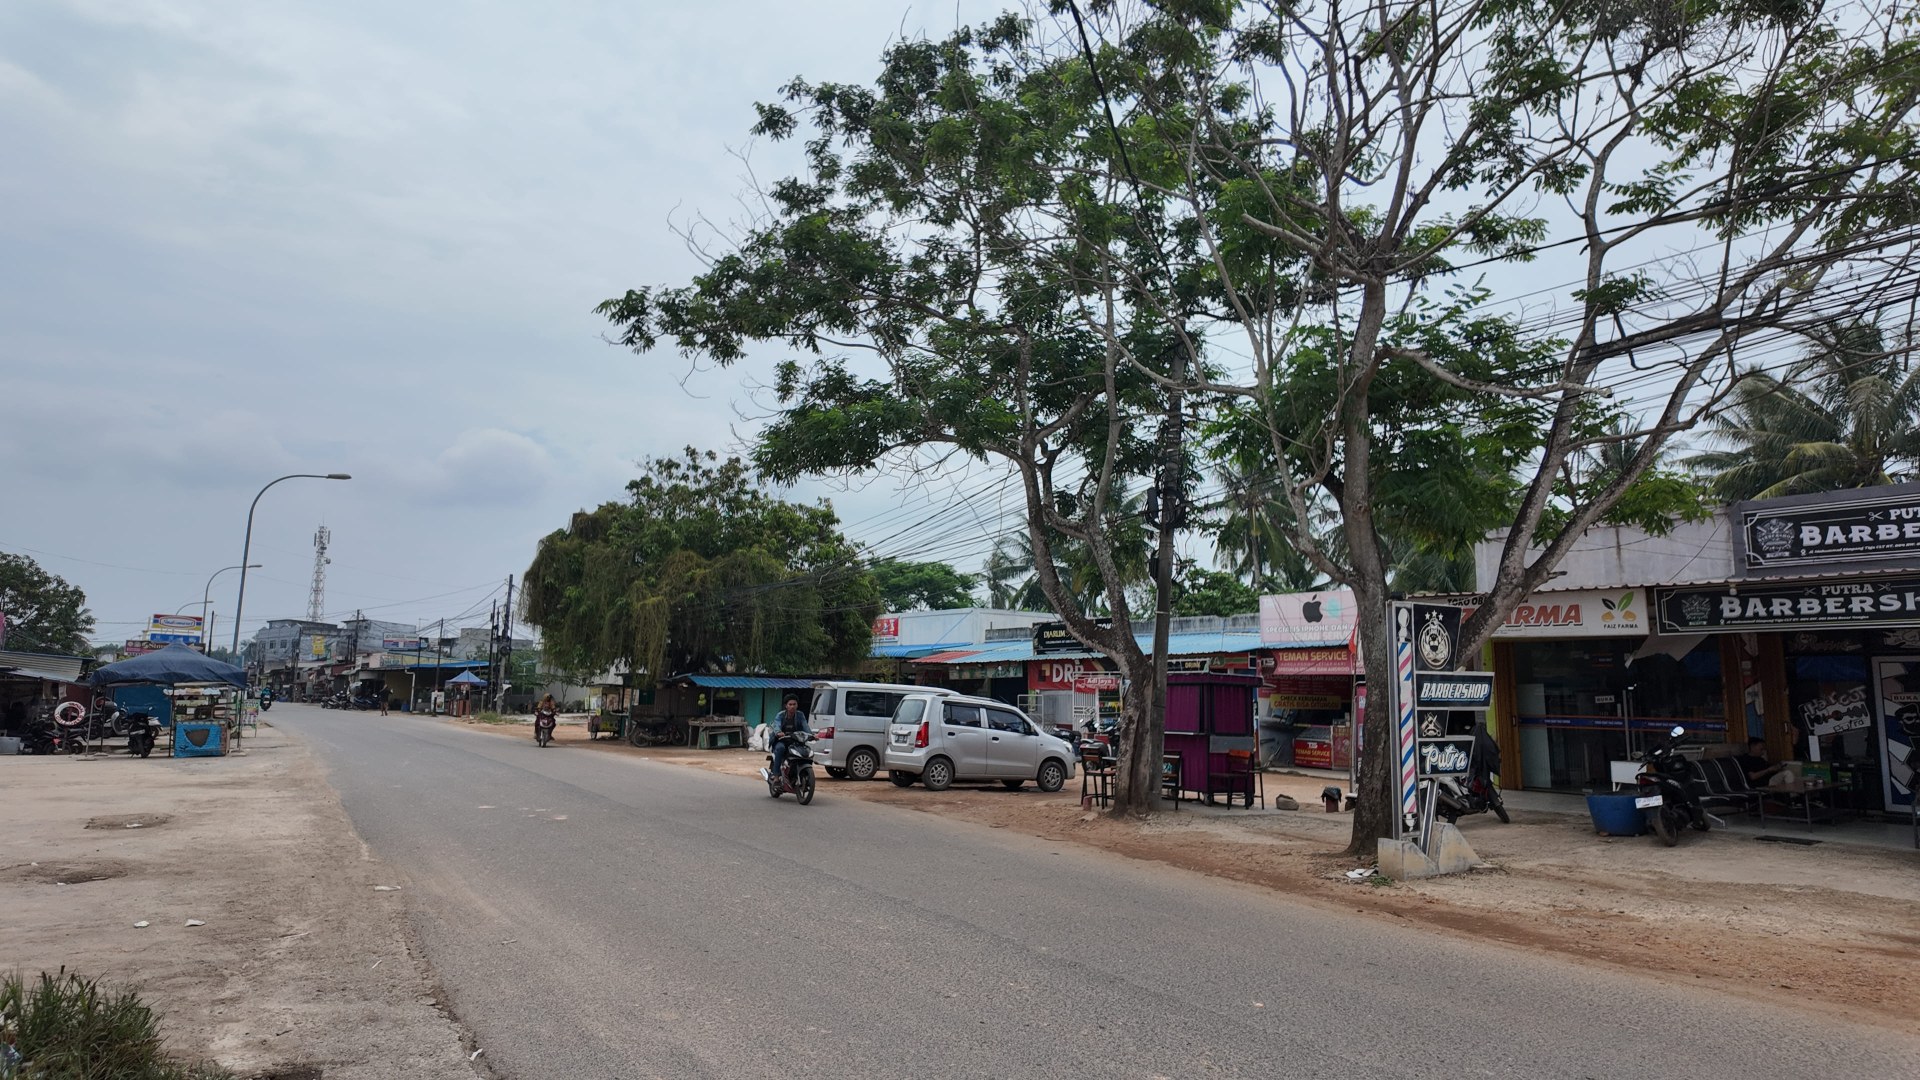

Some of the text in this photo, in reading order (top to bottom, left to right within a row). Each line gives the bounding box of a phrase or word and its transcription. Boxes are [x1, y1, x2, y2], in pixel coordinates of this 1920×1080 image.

[1800, 523, 1920, 547] BARBE
[1821, 583, 1875, 596] PUTRA
[1448, 597, 1470, 606] TOKO
[1502, 604, 1583, 626] RMA
[1279, 651, 1348, 661] TEMAN SERVICE
[1420, 682, 1491, 700] BARBERSHOP
[1311, 749, 1330, 757] SERVICE
[1421, 743, 1468, 774] Putra
